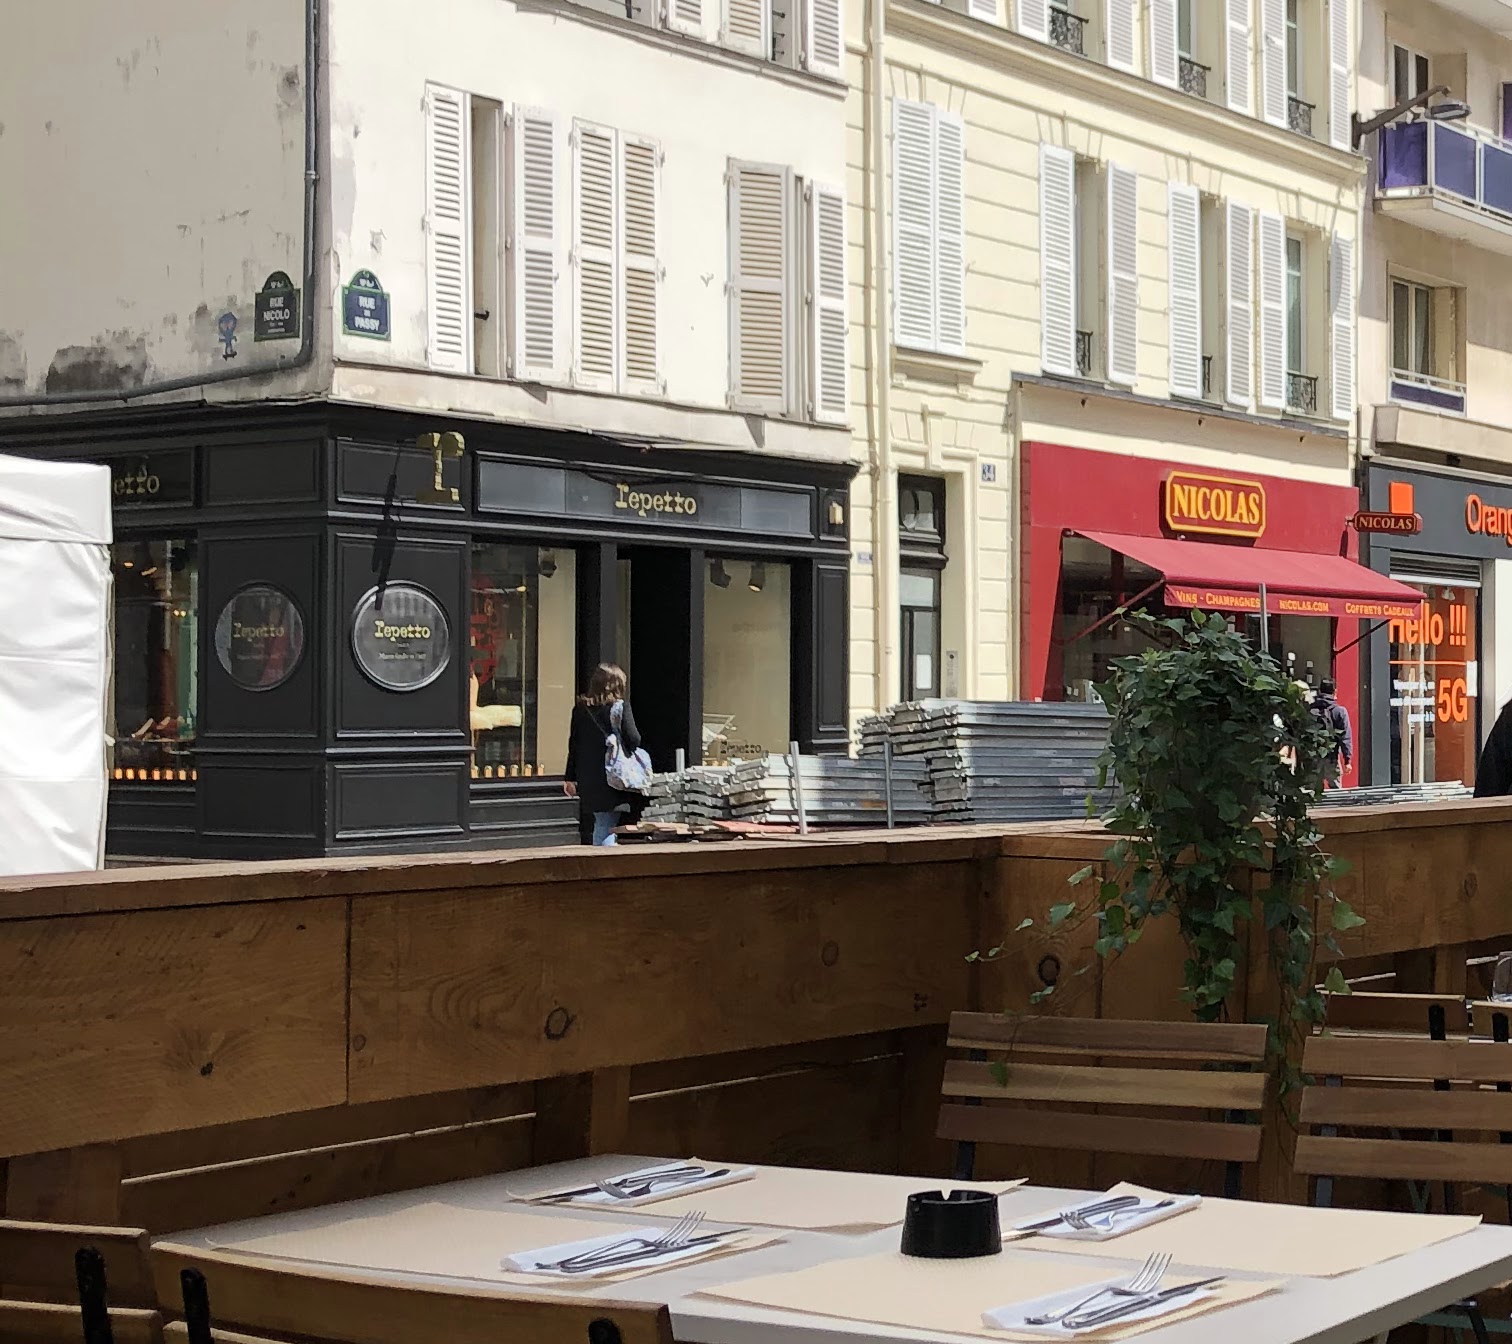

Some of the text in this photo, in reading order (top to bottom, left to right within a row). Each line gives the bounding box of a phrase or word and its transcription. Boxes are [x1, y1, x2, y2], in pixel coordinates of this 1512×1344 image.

[269, 296, 284, 308] RUE
[358, 295, 376, 310] RUE
[263, 308, 291, 322] NICOLO
[354, 315, 380, 331] PASSY
[615, 482, 697, 517] repetto
[1172, 483, 1260, 526] NICOLAS
[1358, 515, 1412, 530] NICOLAS
[374, 620, 431, 642] repetto
[1449, 604, 1467, 646] !!!
[1438, 678, 1468, 723] 5G
